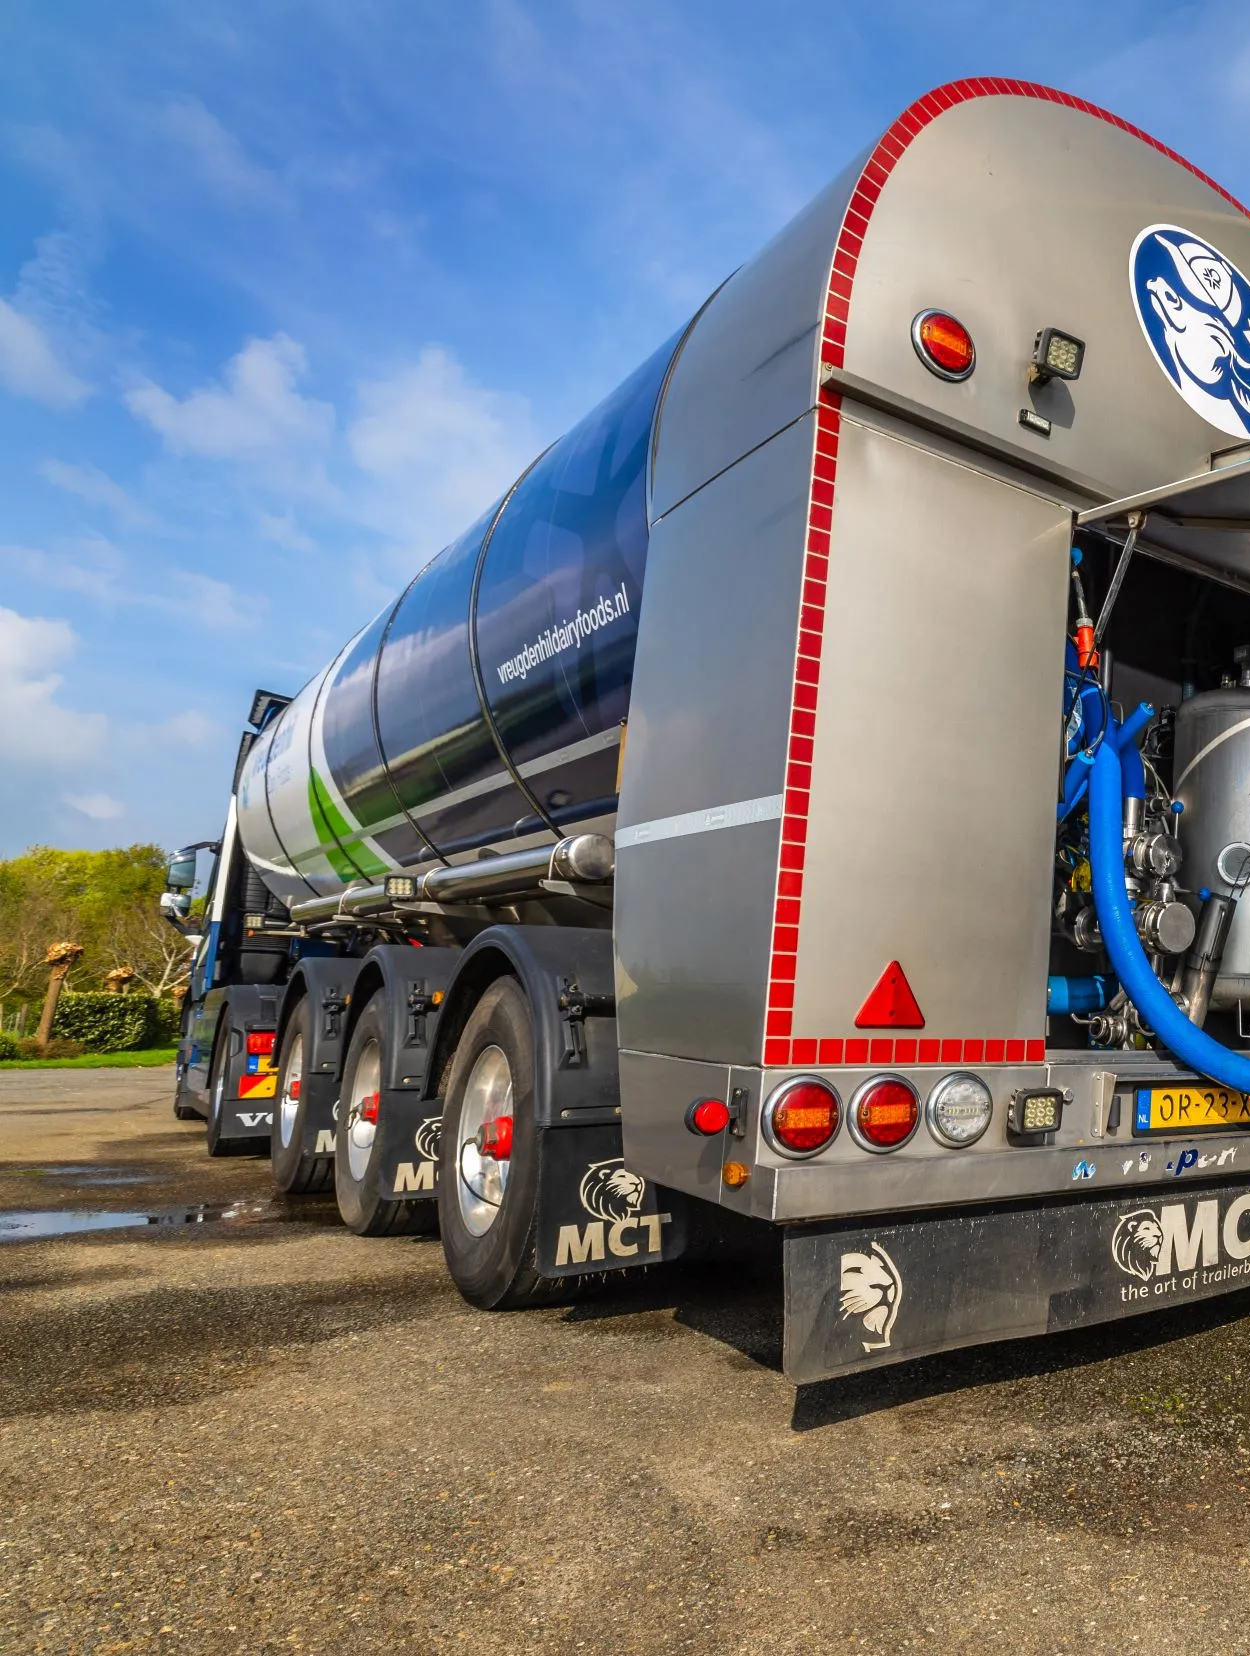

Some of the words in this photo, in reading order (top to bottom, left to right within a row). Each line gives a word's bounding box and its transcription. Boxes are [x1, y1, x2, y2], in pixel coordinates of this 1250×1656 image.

[496, 582, 630, 684] vreugdenhildairyfoods.nl
[1138, 1114, 1149, 1123] NL
[555, 1212, 673, 1266] MCT
[1120, 1284, 1149, 1302] the
[1154, 1277, 1177, 1295] art
[1182, 1270, 1199, 1290] of
